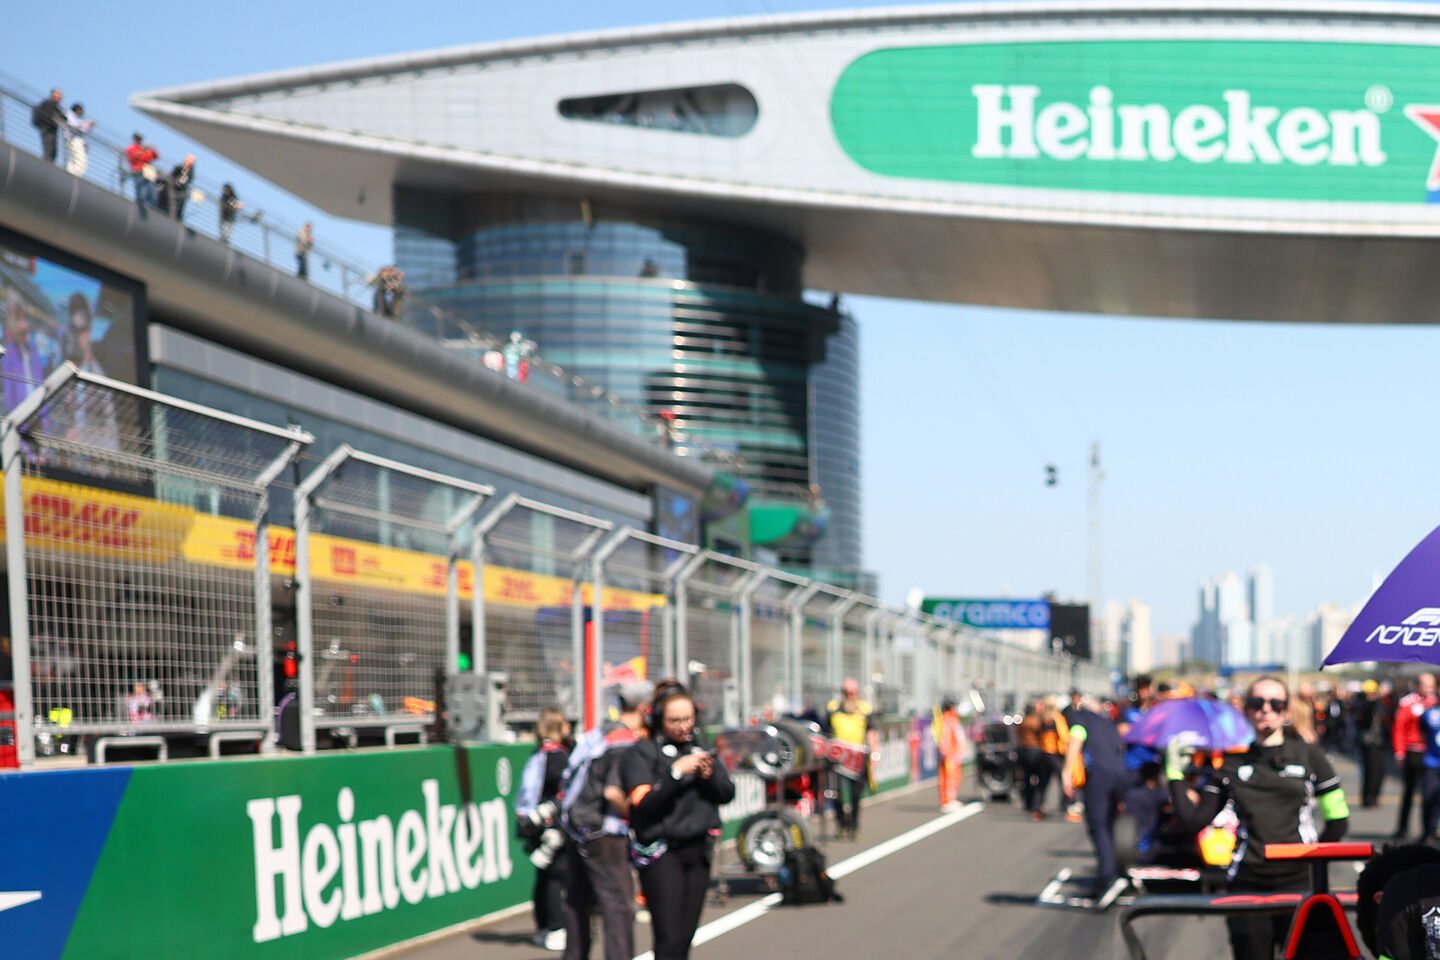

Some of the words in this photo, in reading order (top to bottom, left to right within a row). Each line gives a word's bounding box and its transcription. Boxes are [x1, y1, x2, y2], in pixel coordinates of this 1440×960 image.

[971, 84, 1388, 166] Heineken
[933, 602, 1051, 626] aramco
[246, 778, 513, 943] Heineken
